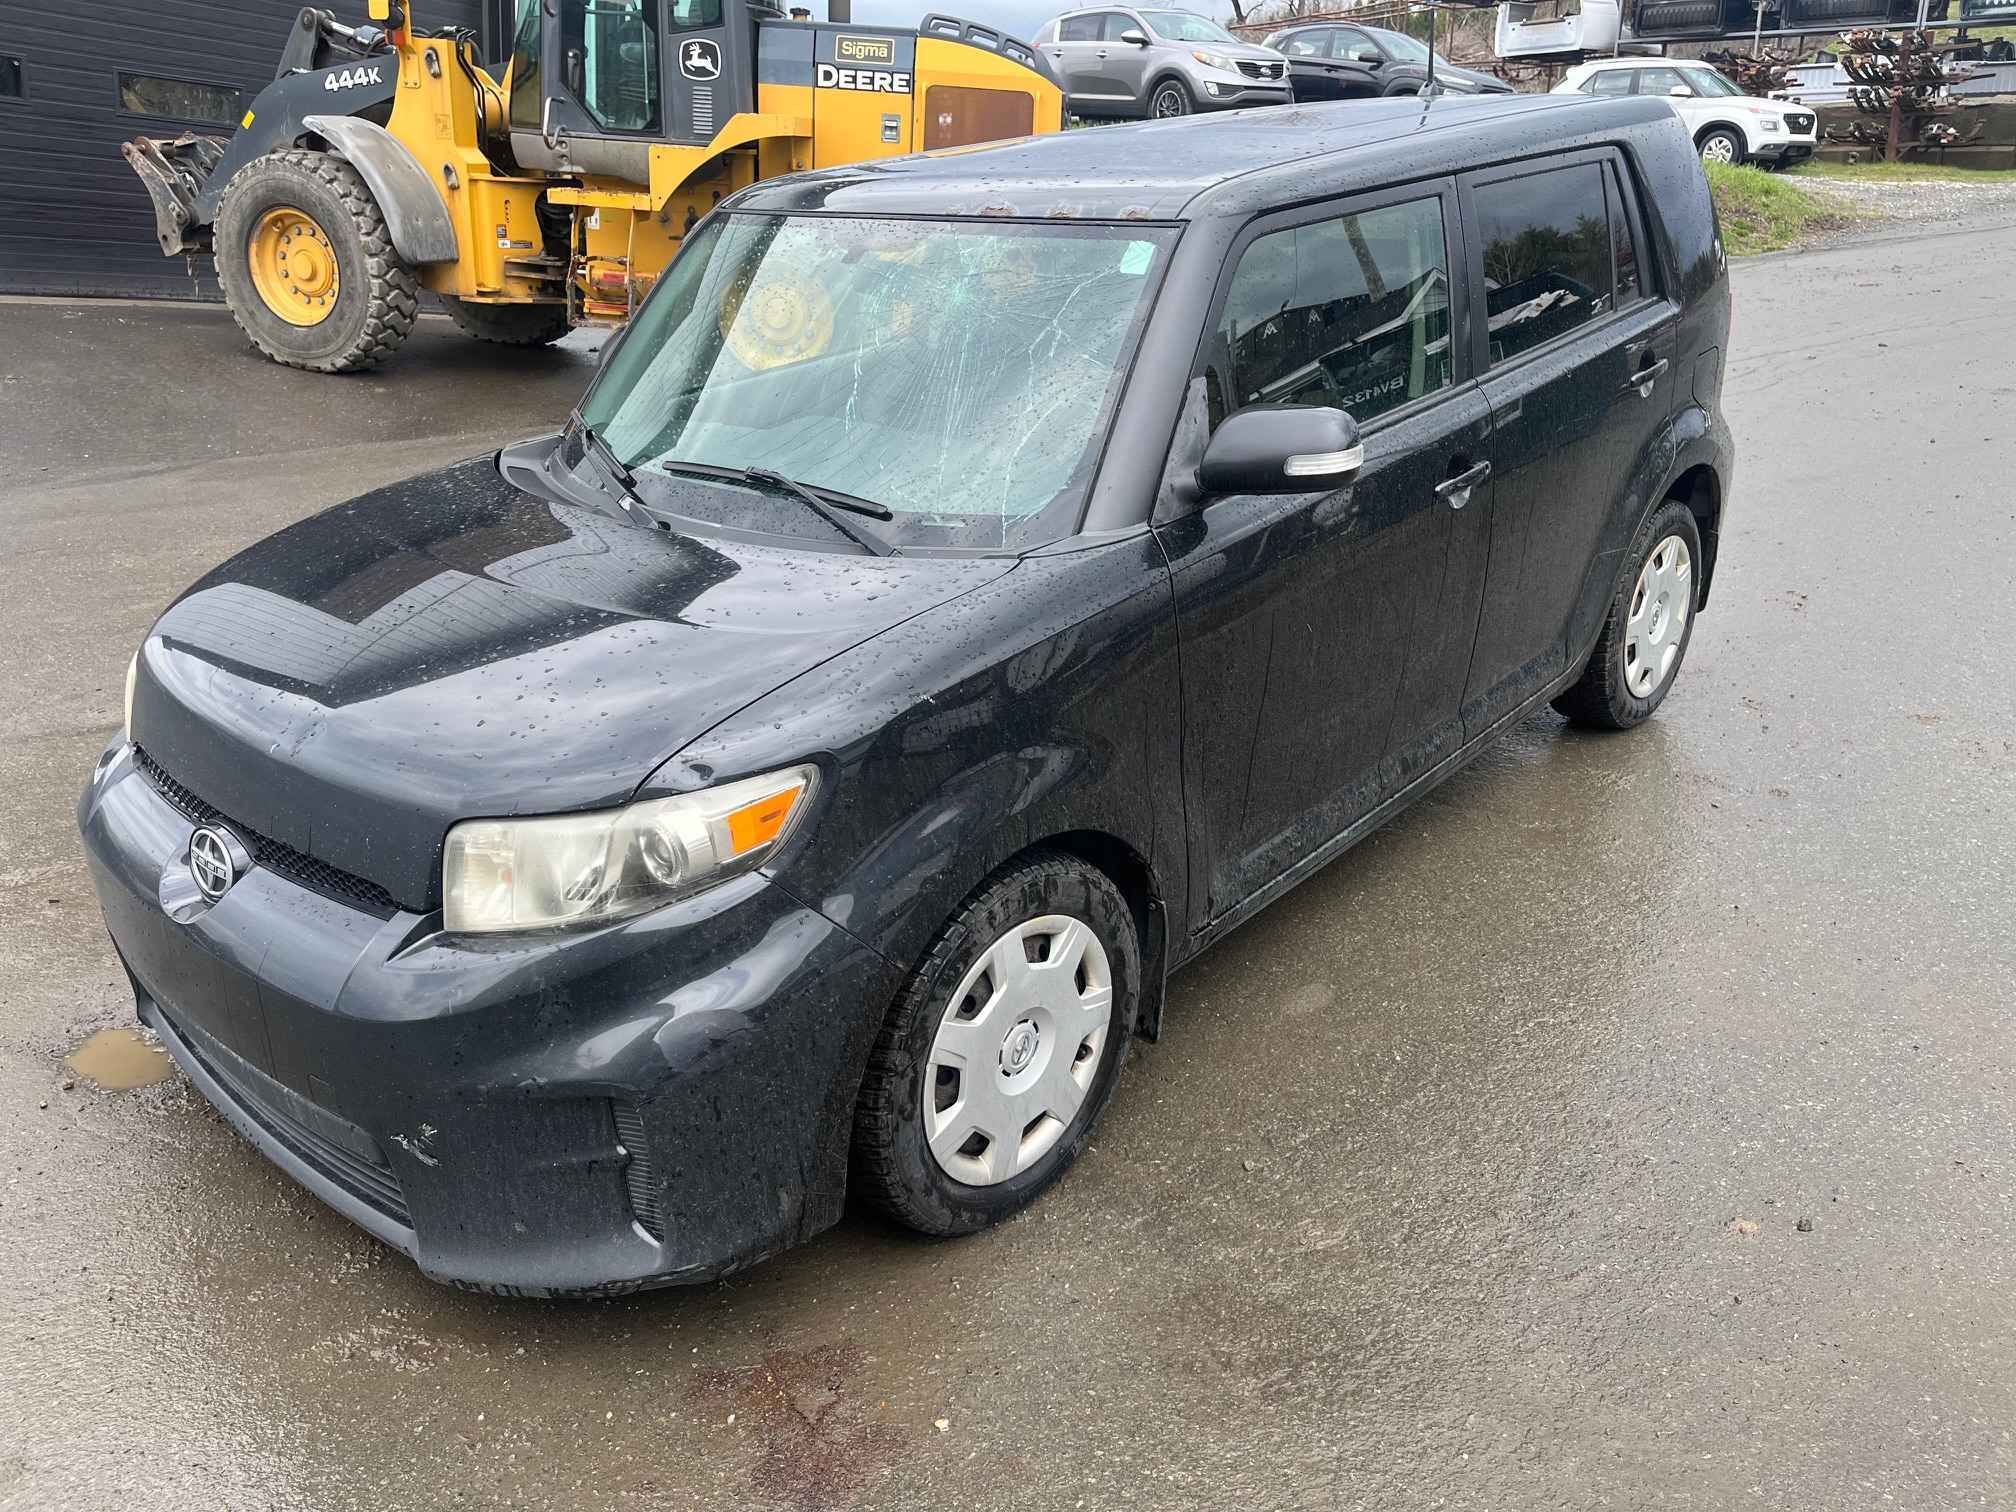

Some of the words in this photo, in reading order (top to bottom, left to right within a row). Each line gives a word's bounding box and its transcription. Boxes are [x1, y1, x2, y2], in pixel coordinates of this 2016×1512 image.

[841, 41, 889, 59] Sigma
[324, 66, 383, 92] 444K
[816, 63, 911, 93] DEERE
